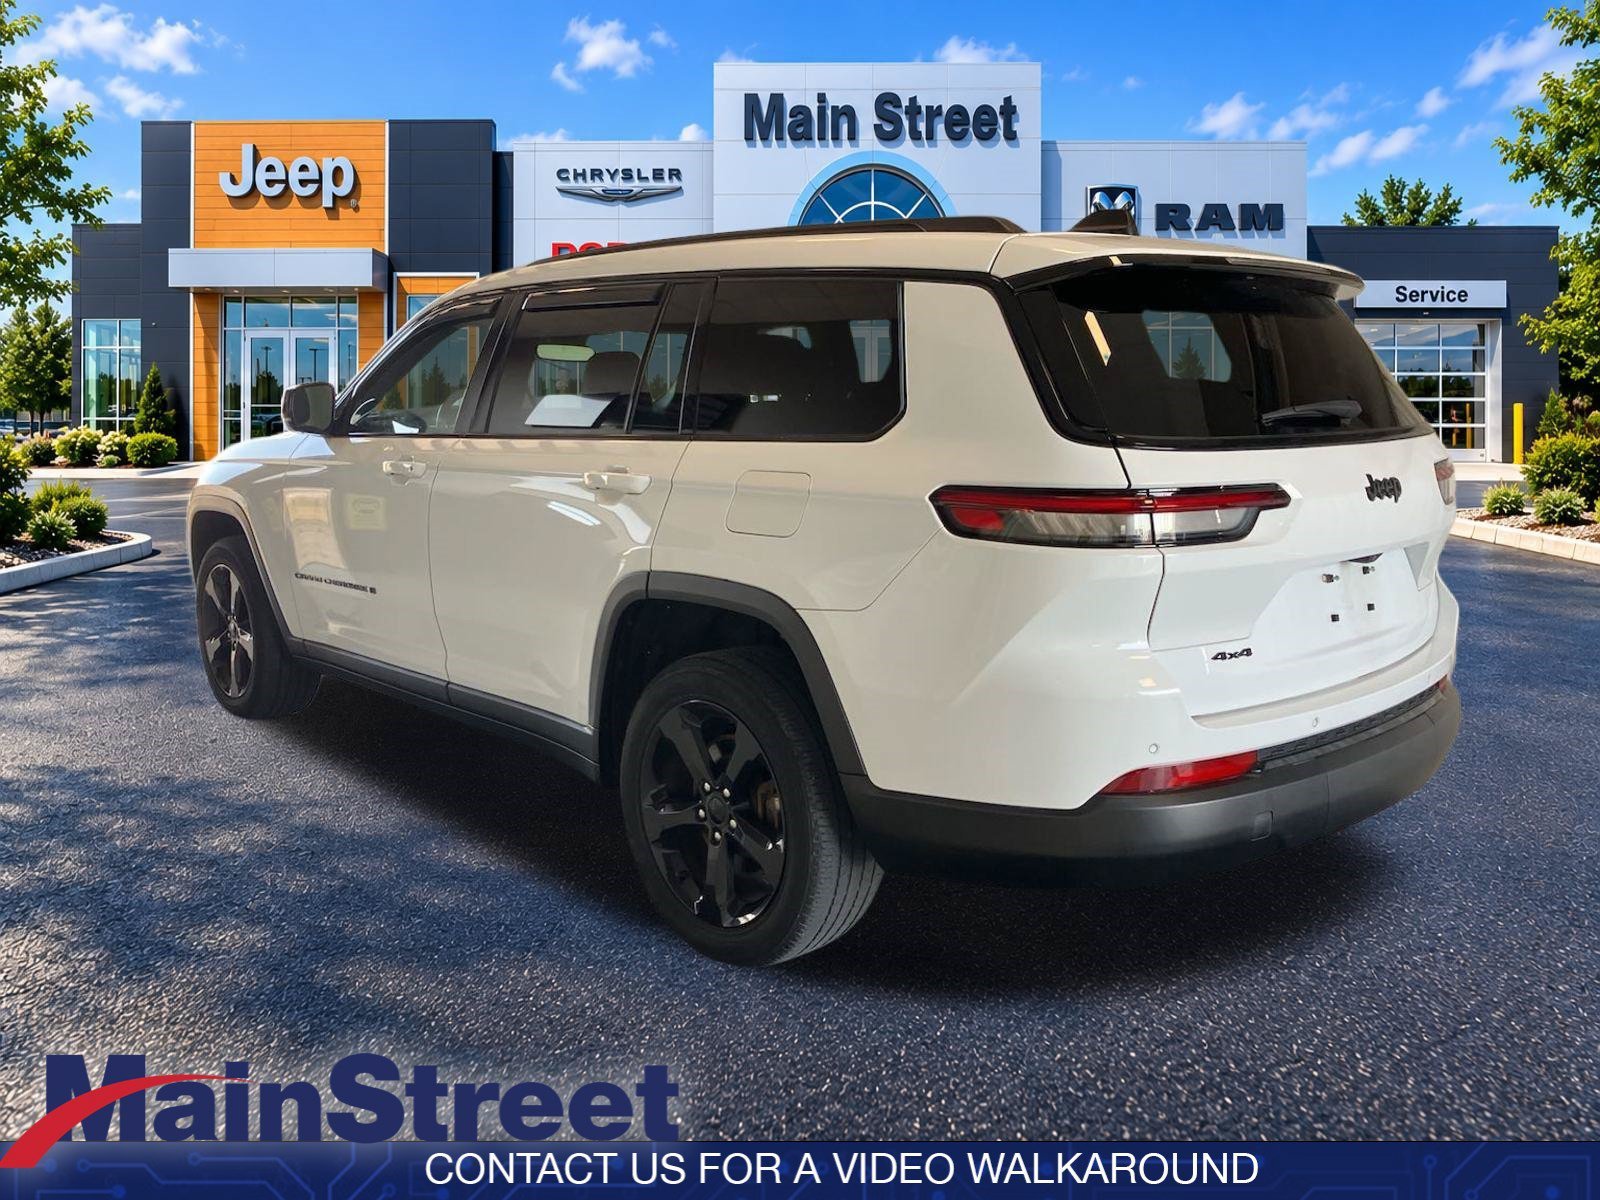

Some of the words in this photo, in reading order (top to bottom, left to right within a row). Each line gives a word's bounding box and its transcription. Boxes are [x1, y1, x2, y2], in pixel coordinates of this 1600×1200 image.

[743, 92, 857, 142] Main
[873, 91, 1018, 142] Street
[218, 143, 355, 208] Jeep
[556, 168, 682, 183] CHRYSLER
[1155, 203, 1284, 231] RAM
[1395, 285, 1469, 303] Service
[1365, 474, 1402, 503] Jeep
[1211, 647, 1253, 661] 4x4
